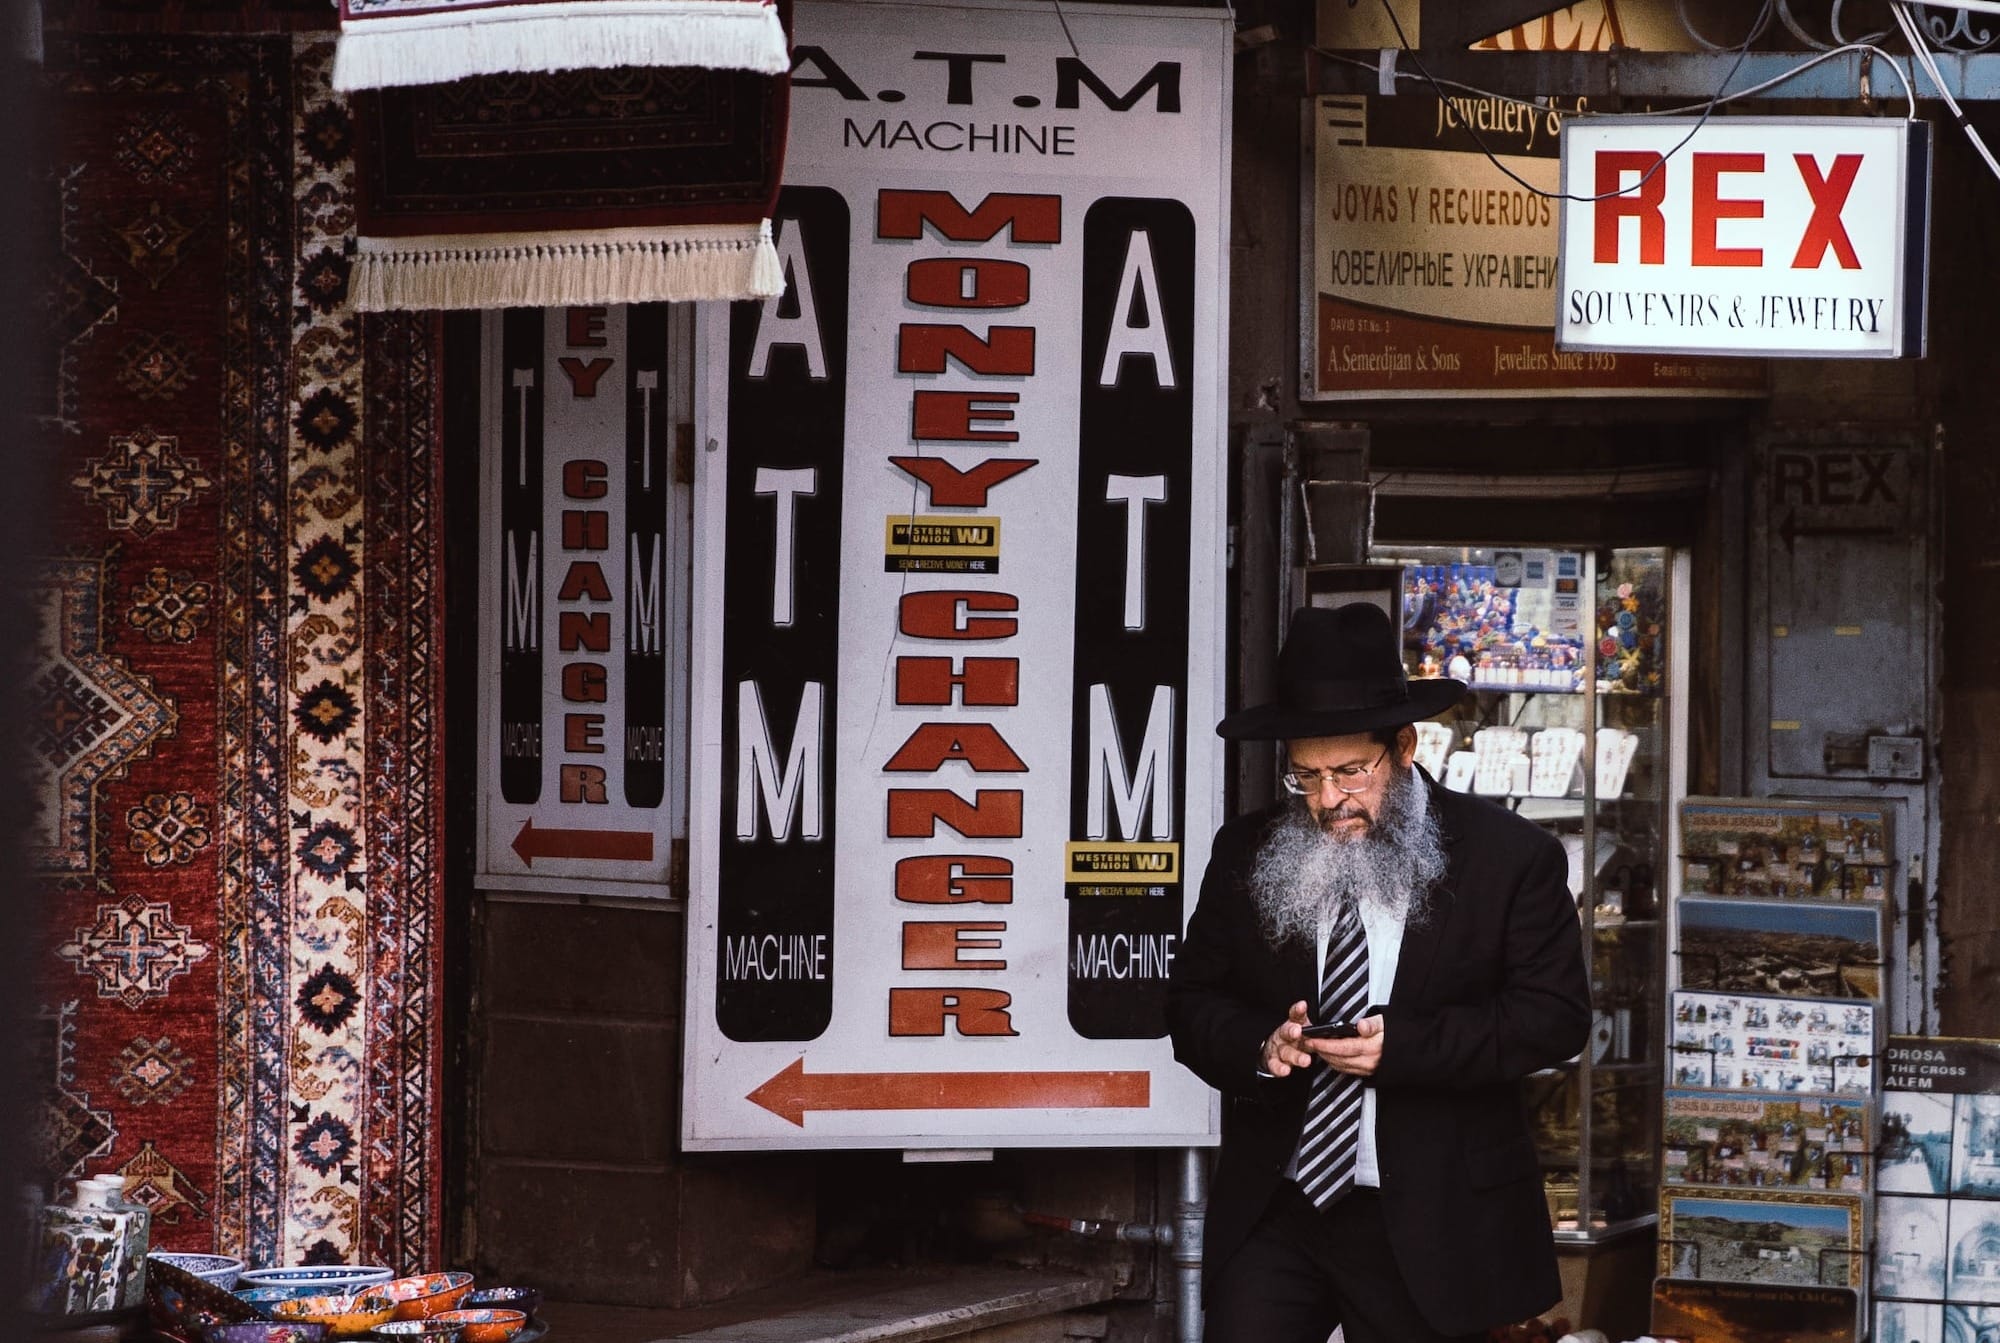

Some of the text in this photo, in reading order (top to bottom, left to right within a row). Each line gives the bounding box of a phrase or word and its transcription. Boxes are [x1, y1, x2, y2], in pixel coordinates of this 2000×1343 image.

[843, 117, 1076, 155] MACHINE
[1436, 95, 1539, 150] Jewellery
[1332, 183, 1551, 227] JOYAS Y RECUERDOS
[1594, 150, 1864, 270] REX
[1332, 250, 1454, 287] ЮВЕЛИРНЫЕ
[1330, 317, 1355, 331] DAVID
[1569, 289, 1884, 333] SOUVENIRS & JEWELRY
[1415, 346, 1429, 371] &
[1432, 344, 1460, 371] Sons
[1495, 345, 1548, 376] Jewellers
[1775, 453, 1898, 505] REX
[896, 527, 988, 544] WESTERN WU
[913, 535, 951, 543] UNION
[557, 459, 613, 804] CHANGER
[875, 188, 1062, 1038] MONEY CHANGER
[503, 722, 539, 758] MACHINE
[627, 726, 663, 762] MACHINE
[1075, 853, 1167, 871] WESTERN WU
[1092, 862, 1130, 870] UNION
[725, 932, 827, 982] MACHINE
[1076, 933, 1176, 979] MACHINE
[1890, 1064, 1966, 1076] THE CROSS
